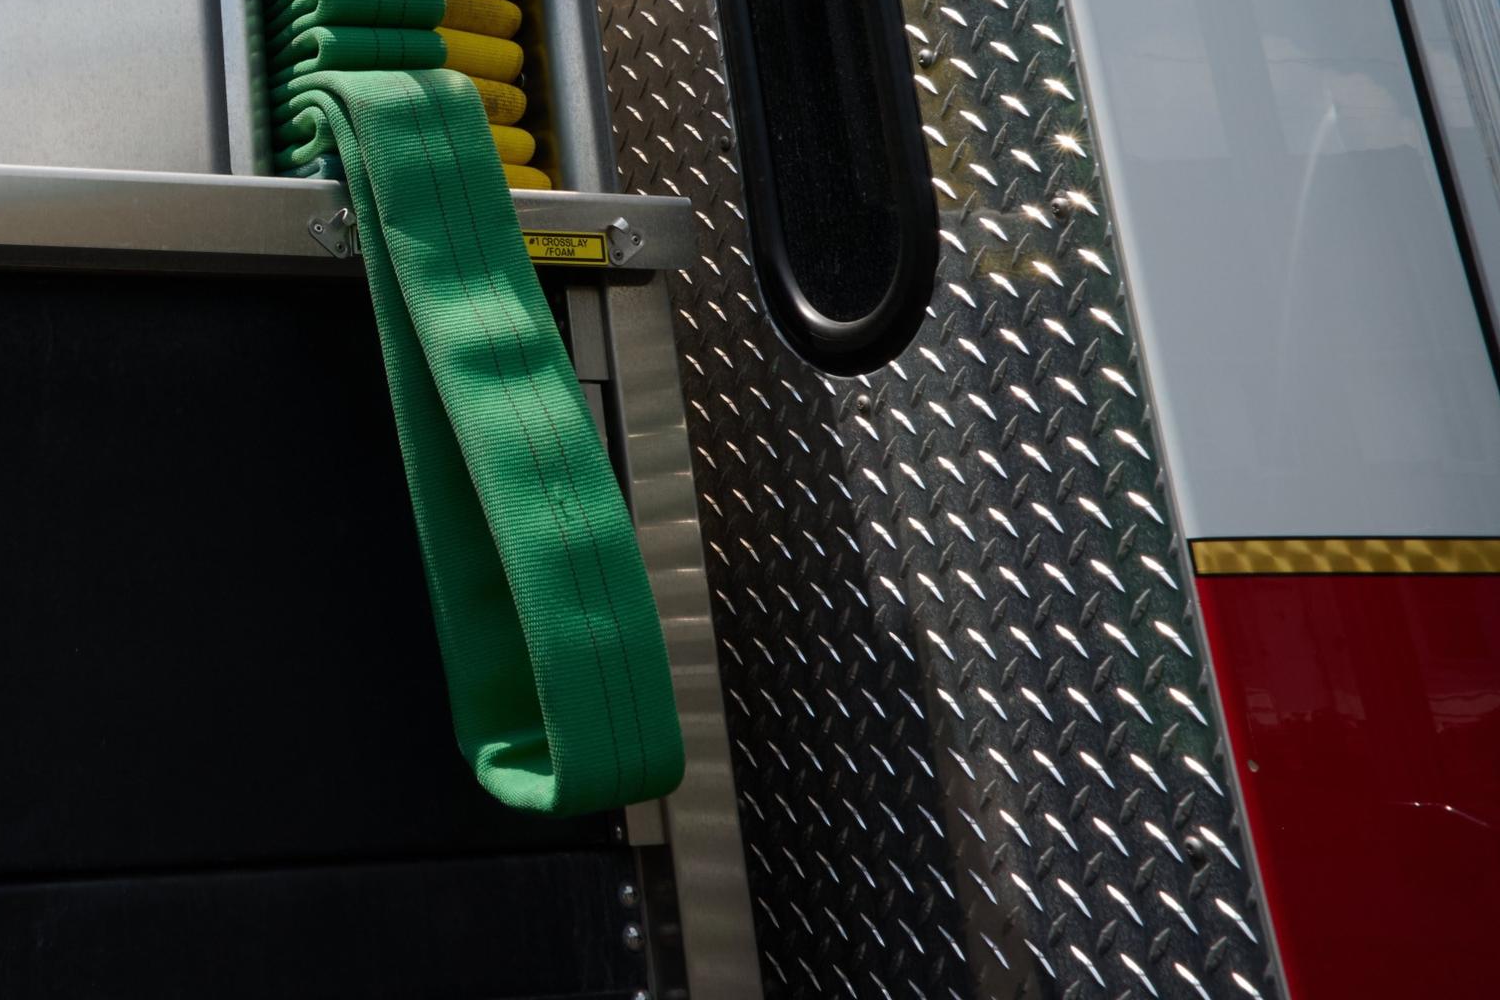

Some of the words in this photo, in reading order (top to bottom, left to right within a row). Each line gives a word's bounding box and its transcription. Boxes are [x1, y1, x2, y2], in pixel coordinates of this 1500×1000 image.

[529, 237, 540, 246] #1
[541, 237, 589, 248] CROSSLAY
[544, 247, 576, 257] /FOAM
